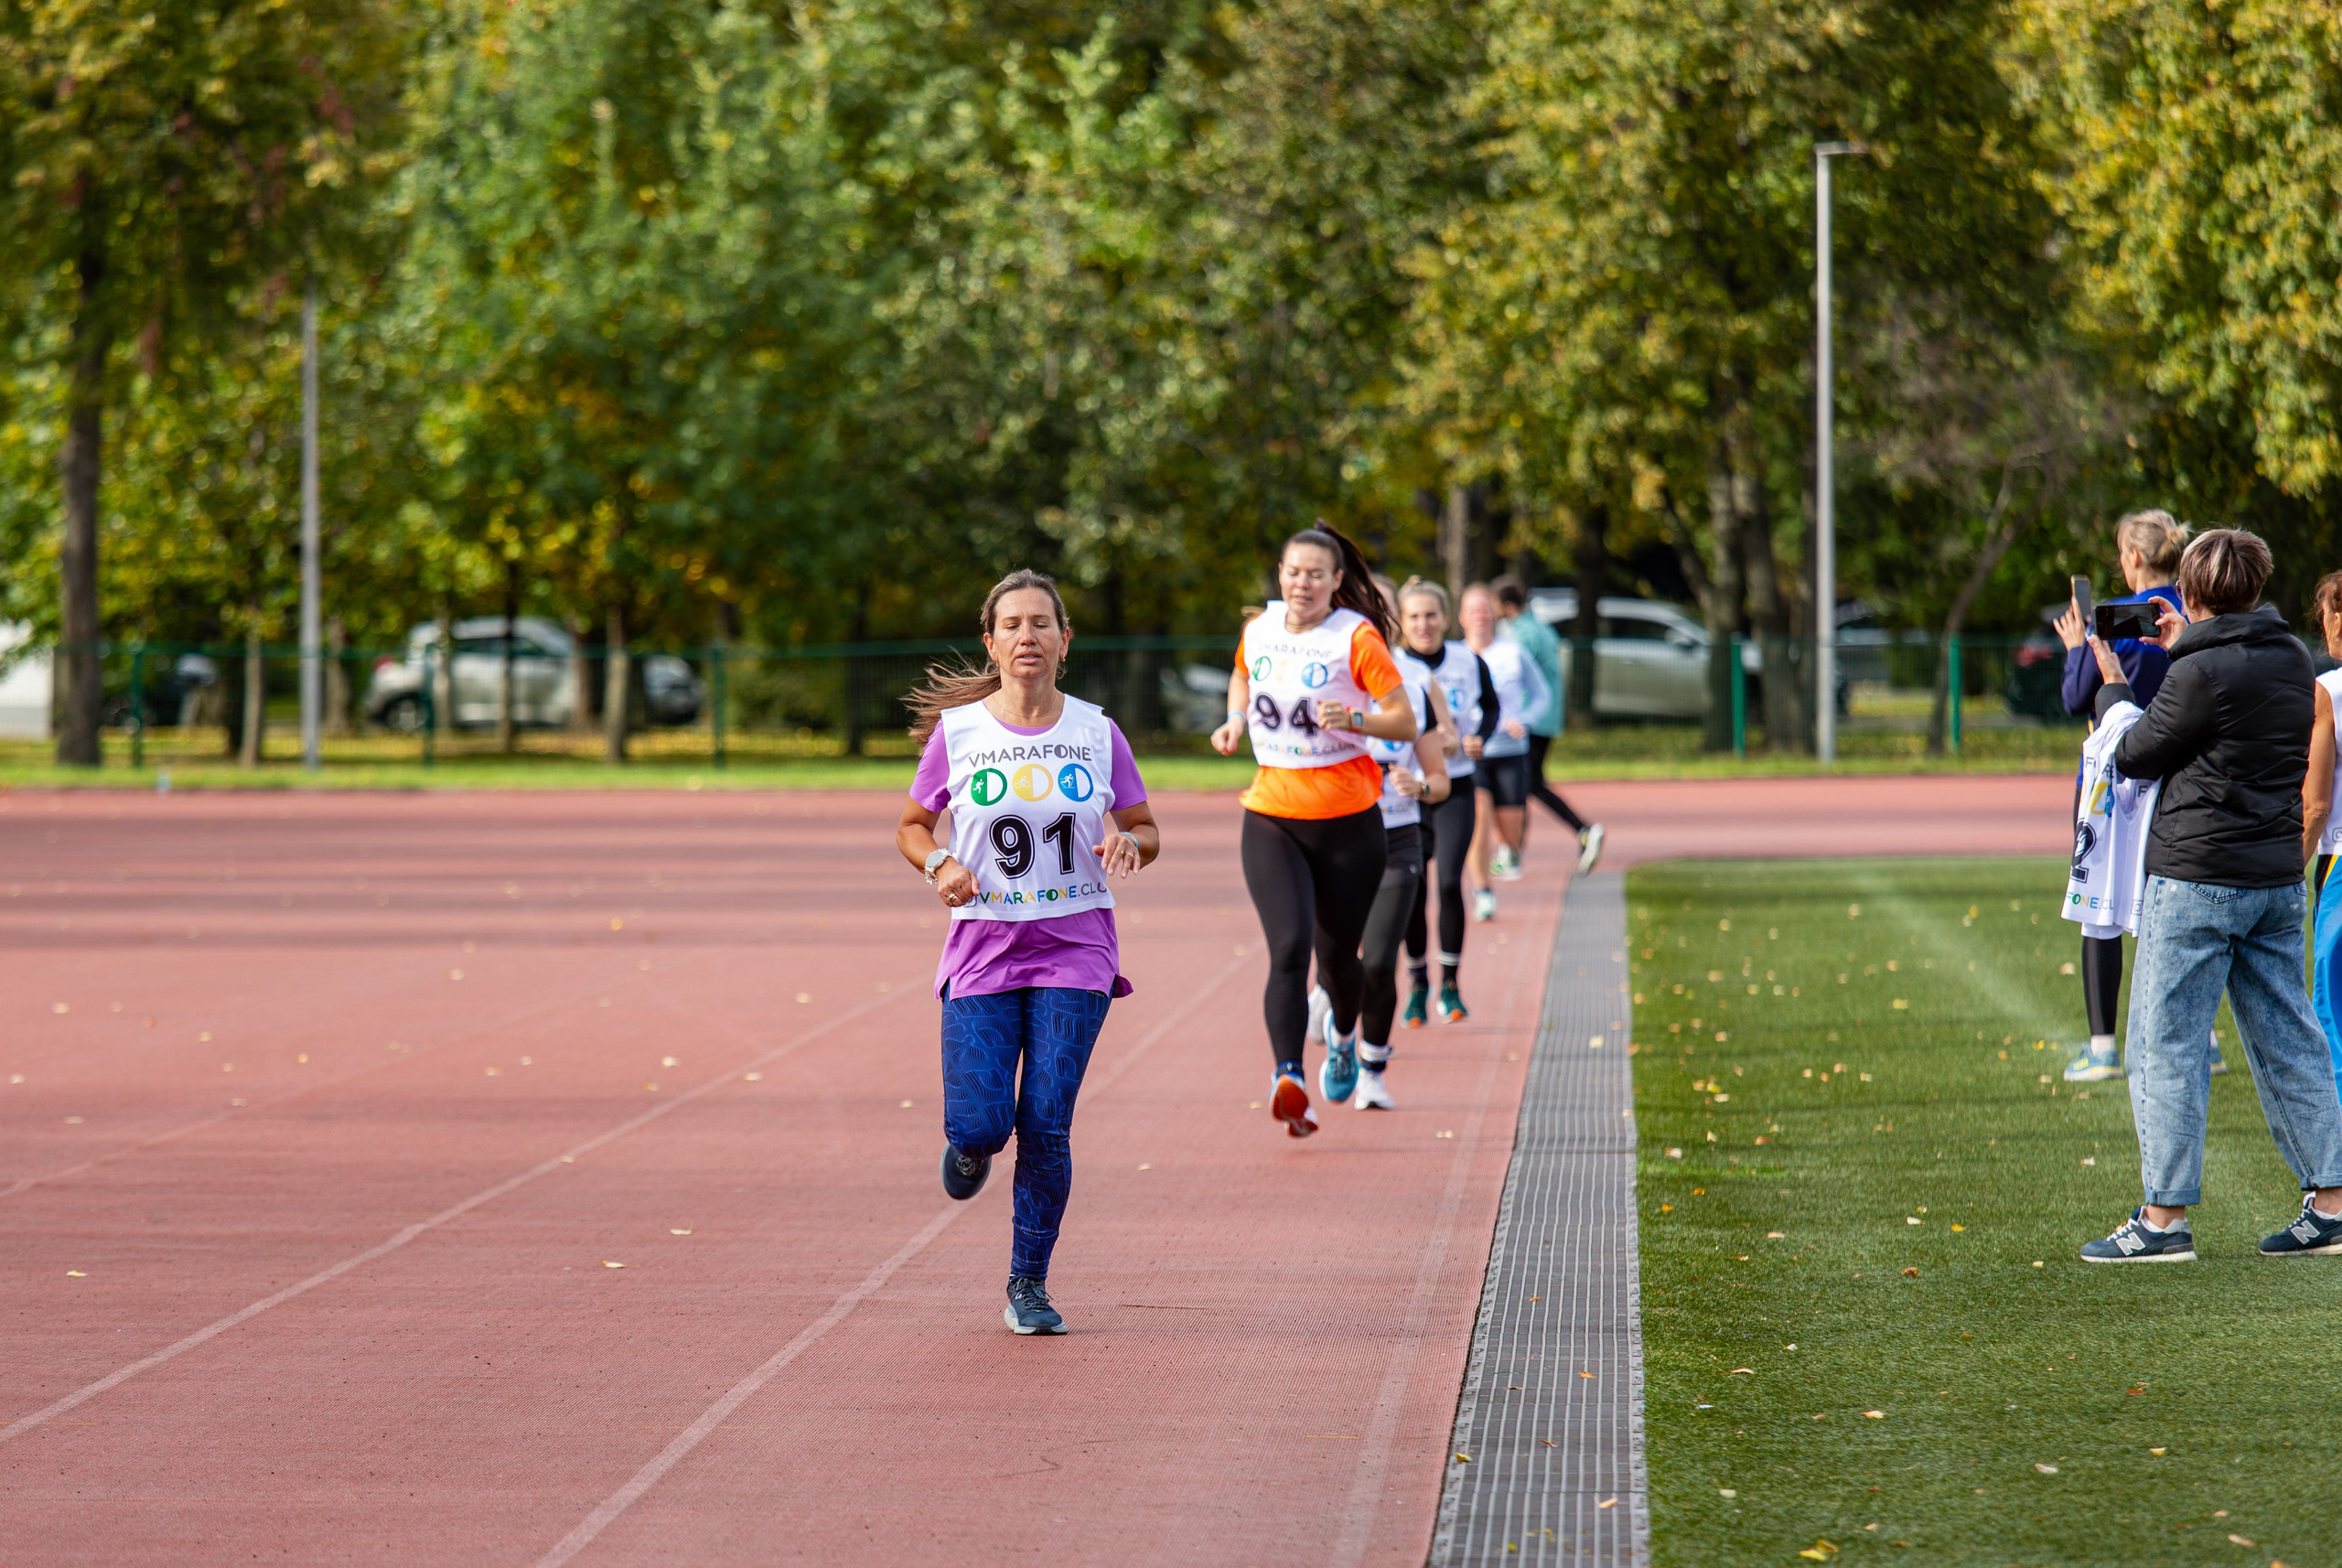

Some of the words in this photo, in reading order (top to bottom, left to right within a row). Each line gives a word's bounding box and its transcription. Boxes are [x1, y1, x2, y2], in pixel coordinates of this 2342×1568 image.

[1255, 692, 1320, 738] 94
[969, 744, 1092, 768] VMARAFONE
[989, 811, 1076, 880] 91
